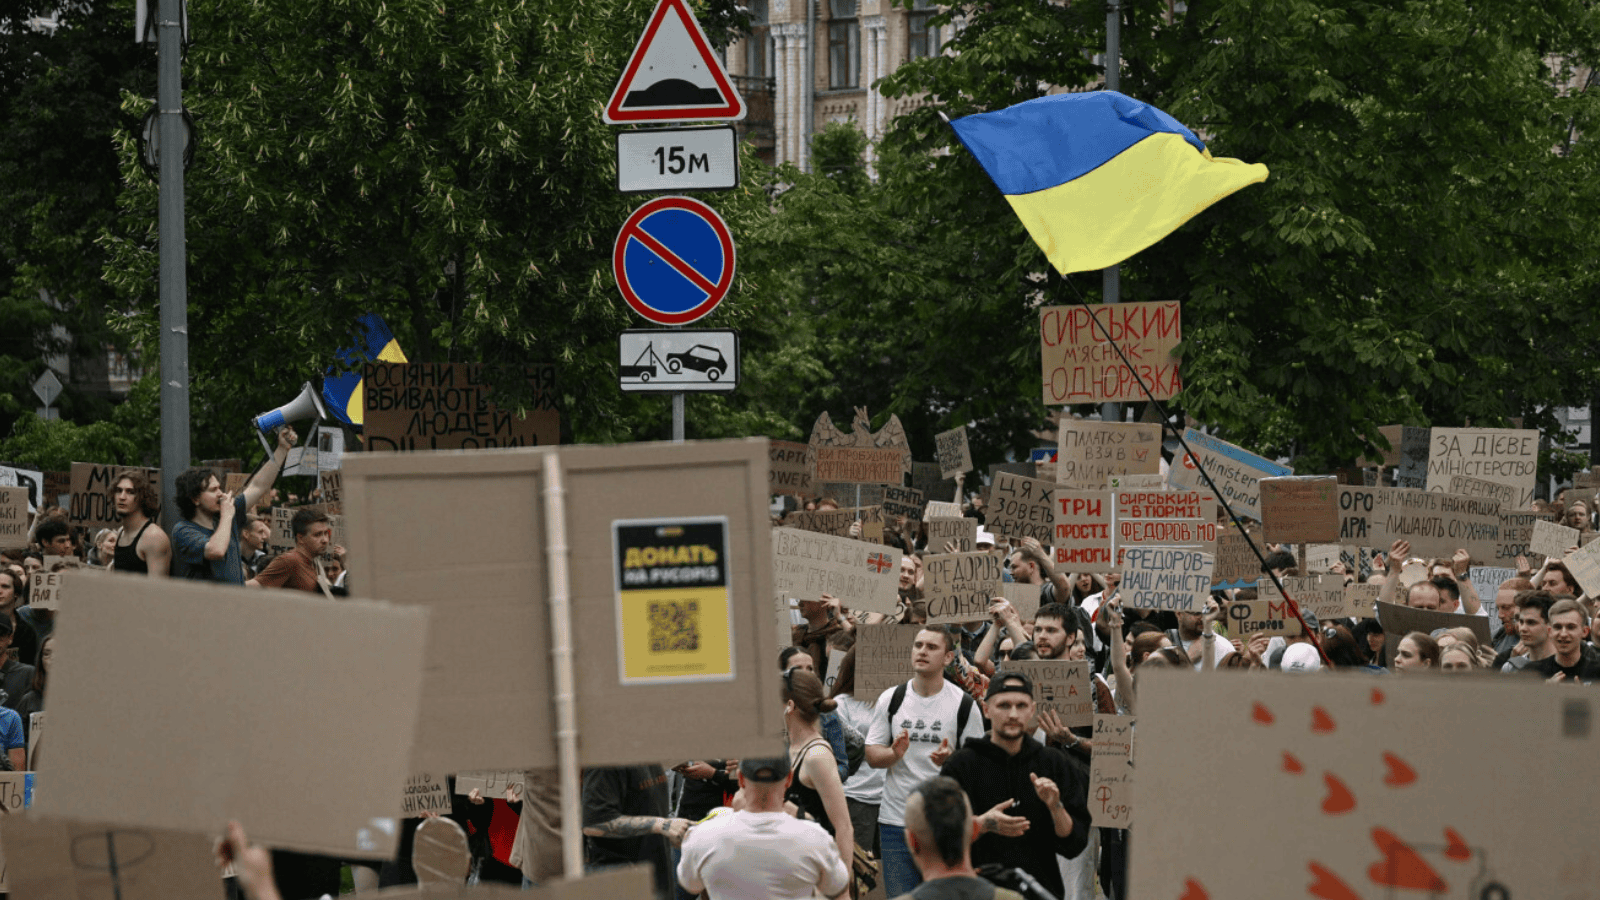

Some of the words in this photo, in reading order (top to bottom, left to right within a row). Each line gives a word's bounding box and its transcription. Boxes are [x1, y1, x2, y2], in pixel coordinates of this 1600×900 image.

[1042, 303, 1179, 347] СИРСЬКИЙ
[364, 363, 453, 388] РОСІЯНИ
[367, 387, 488, 411] ВБИВАЮТЬ
[406, 411, 512, 436] ЛЮДЕЙ
[1085, 446, 1126, 460] ВЗЯВ
[1436, 435, 1462, 457] ЗА
[1471, 434, 1532, 457] ДІЄВЕ
[1202, 455, 1257, 487] Minister
[1428, 457, 1536, 476] МІНІСТЕРСТВО
[1222, 481, 1260, 507] found
[1376, 489, 1437, 510] ЗНІМАЮТЬ
[1059, 498, 1102, 516] ТРИ
[929, 520, 971, 538] ФЕДОРОВ
[1056, 523, 1109, 539] ПРОСТІ
[1386, 514, 1445, 538] ЛИШАЮТЬ
[625, 545, 718, 568] ДОНАТЬ
[777, 531, 864, 568] BRITAIN
[1057, 547, 1111, 563] ВИМОГИ
[928, 555, 1000, 584] ФЕДОРОВ
[1123, 570, 1152, 591] НАШ
[1155, 572, 1211, 592] МІНІСТР
[1133, 591, 1194, 610] ОБОРОНИ
